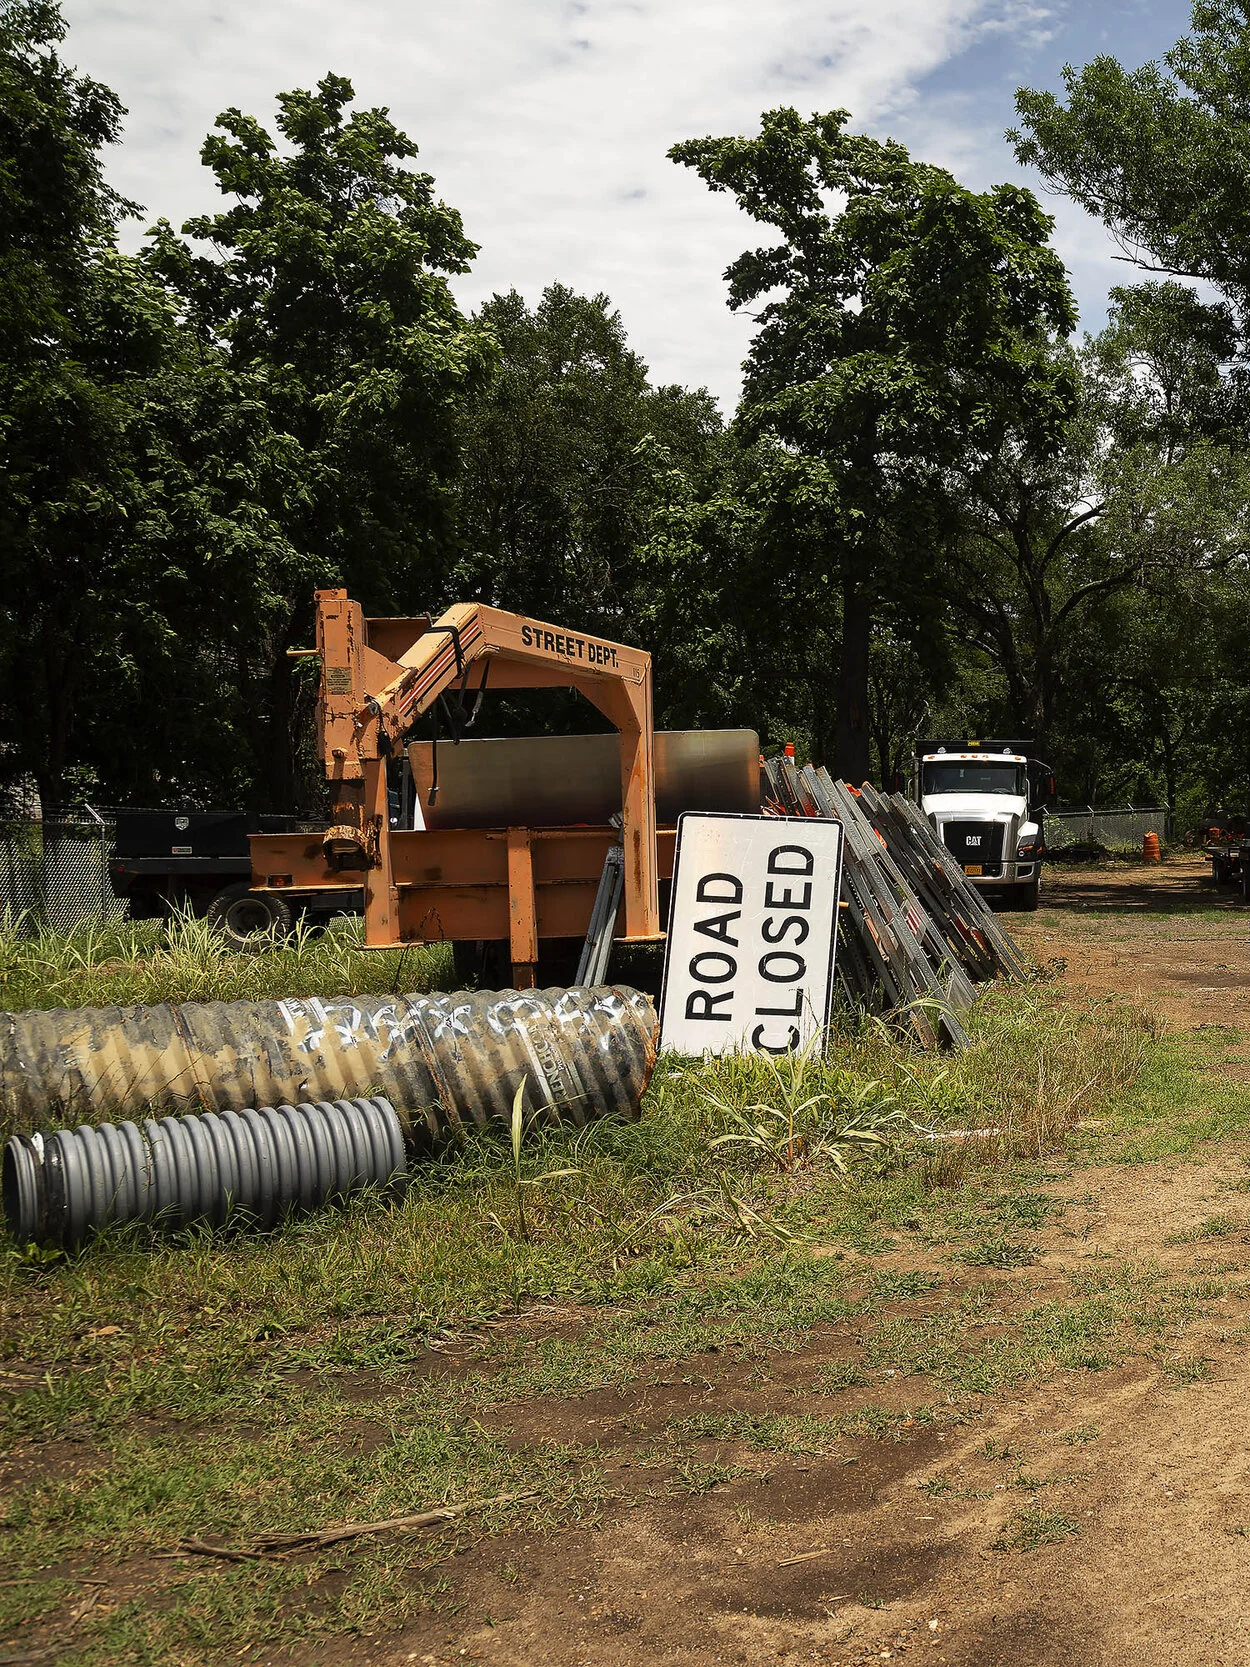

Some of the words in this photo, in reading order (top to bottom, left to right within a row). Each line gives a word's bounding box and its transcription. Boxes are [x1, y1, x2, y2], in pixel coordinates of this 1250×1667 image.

[522, 625, 585, 658] STREET
[588, 643, 619, 668] DEPT.
[965, 835, 982, 846] CAT
[684, 872, 744, 1022] ROAD
[751, 844, 815, 1055] CLOSED
